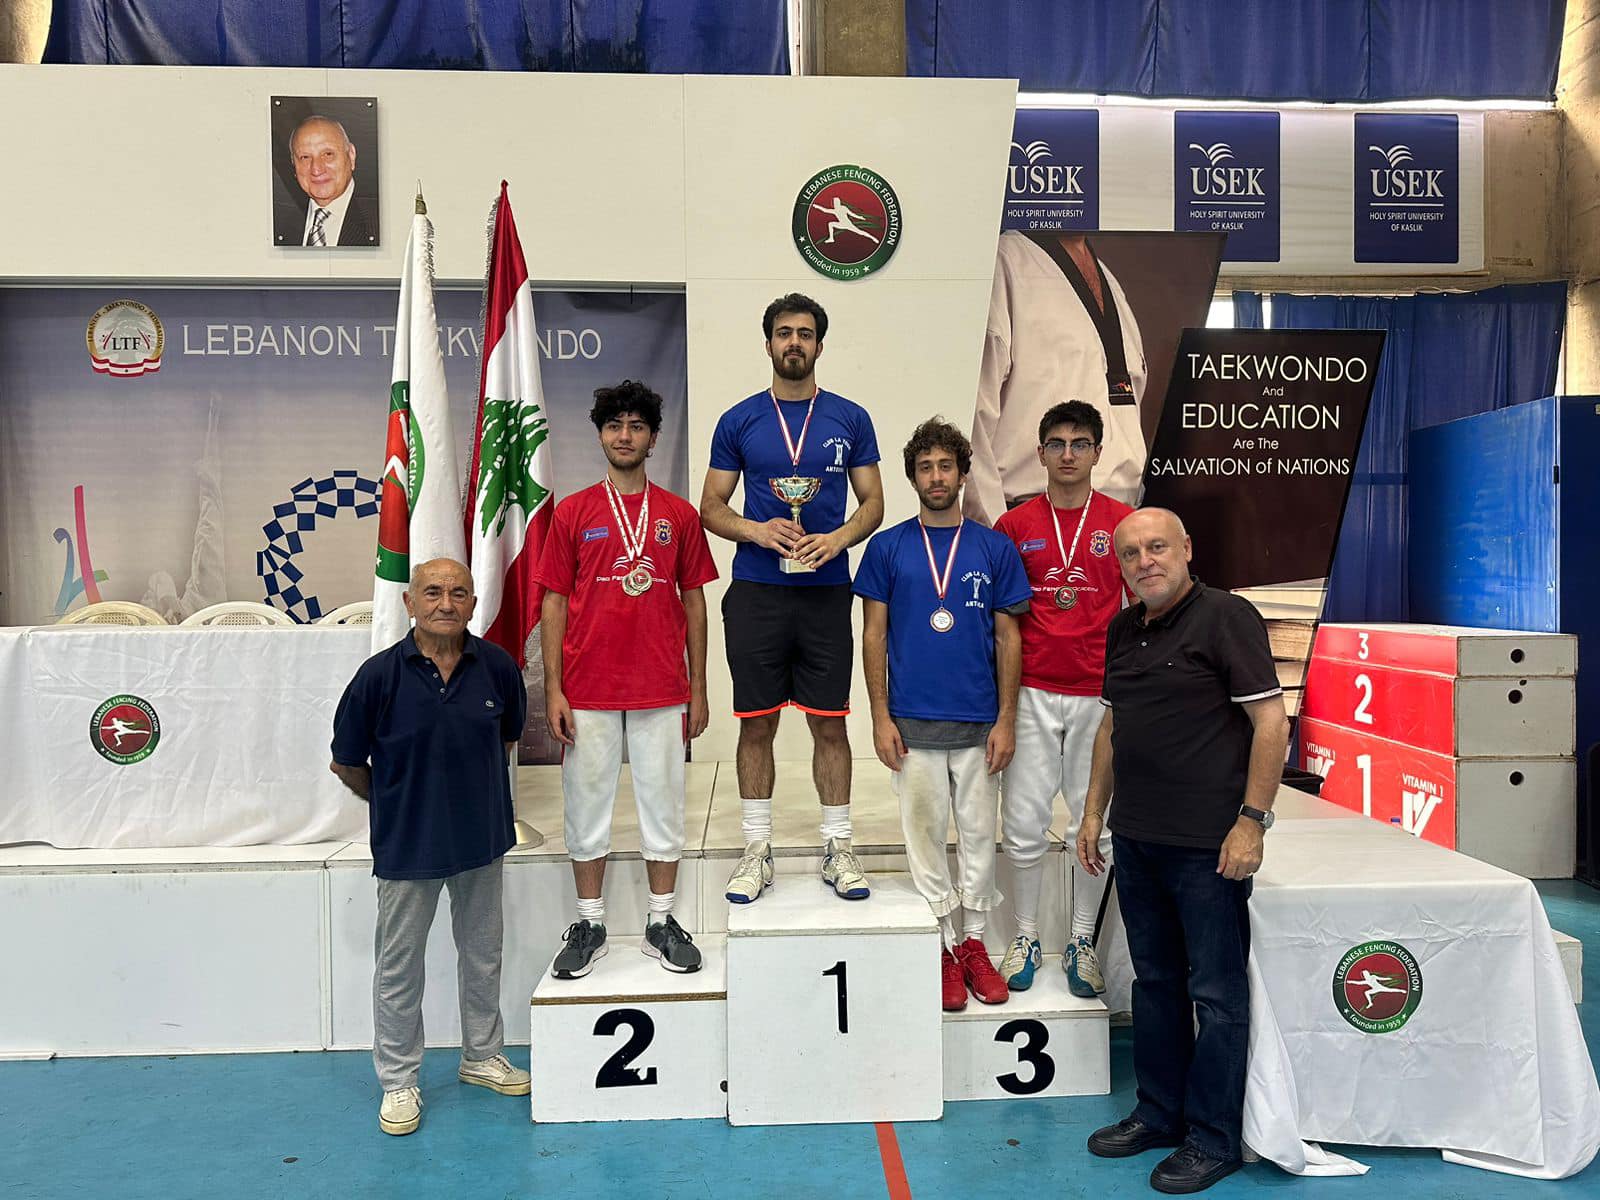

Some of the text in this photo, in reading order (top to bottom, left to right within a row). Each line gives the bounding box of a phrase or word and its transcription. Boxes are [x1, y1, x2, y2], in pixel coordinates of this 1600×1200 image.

[1008, 166, 1084, 194] USEK
[1190, 167, 1265, 195] USEK
[1370, 169, 1444, 197] USEK
[802, 169, 899, 246] LEBANESE FENCING FEDERATION
[1008, 209, 1083, 217] HOLY SPIRIT UNIVERSITY
[1190, 210, 1265, 219] HOLY SPIRIT UNIVERSITY
[1369, 212, 1444, 220] HOLY SPIRIT UNIVERSITY
[1029, 221, 1062, 229] OF KASLIK
[1211, 222, 1244, 230] OF KASLIK
[1391, 223, 1423, 231] OF KASLIK
[803, 245, 860, 277] founded in 1959
[112, 337, 141, 351] LTF
[183, 324, 361, 356] LEBANON
[1188, 353, 1367, 383] TAEKWONDO
[1262, 386, 1284, 396] And
[1182, 403, 1340, 430] EDUCATION
[1233, 438, 1279, 450] Are The
[1151, 457, 1350, 476] SALVATION of NATIONS
[1357, 633, 1369, 660] 3
[1354, 673, 1373, 724] 2
[1306, 742, 1331, 758] VITAMIN
[1356, 754, 1371, 818] 1
[1402, 773, 1437, 795] VITAMIN
[1336, 943, 1420, 991] LEBANESE FENCING FEDERATION
[822, 961, 849, 1034] 1
[1349, 1014, 1377, 1030] founded
[1386, 1019, 1401, 1029] 1959
[592, 1008, 658, 1089] 2
[994, 1018, 1056, 1095] 3
